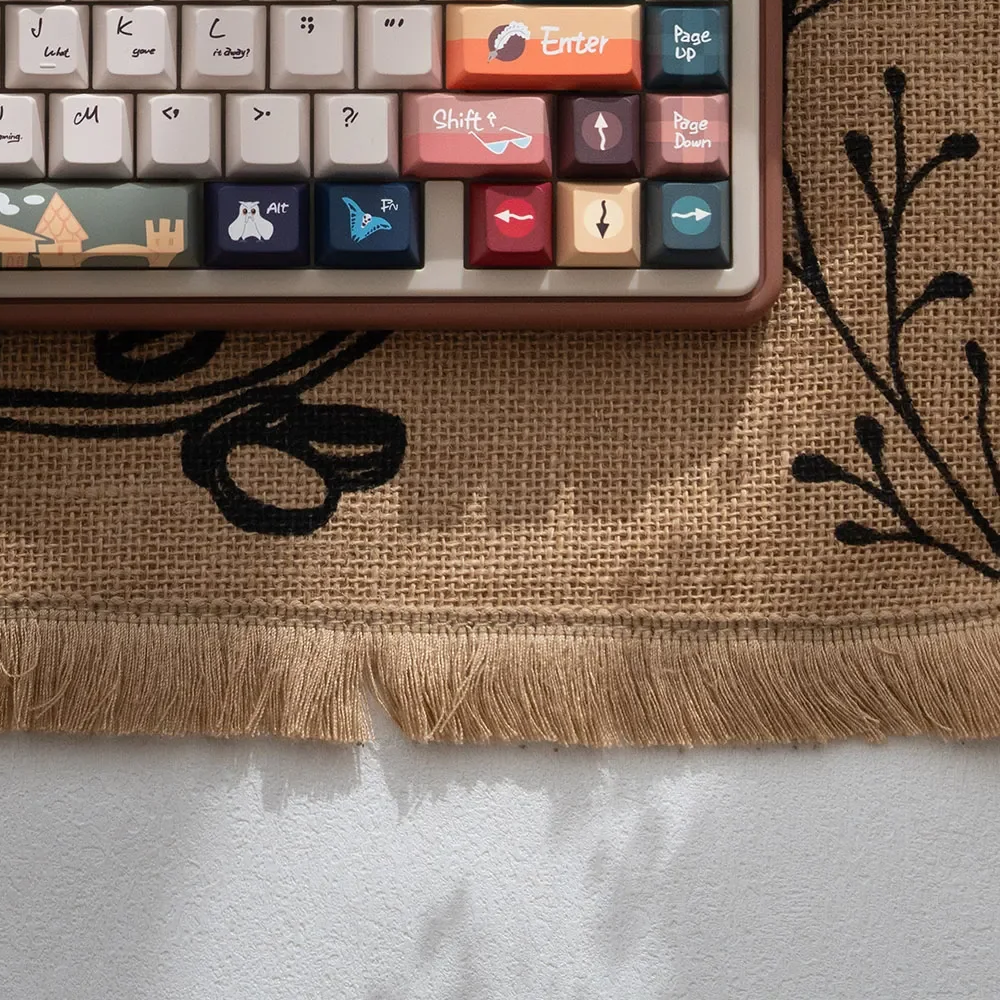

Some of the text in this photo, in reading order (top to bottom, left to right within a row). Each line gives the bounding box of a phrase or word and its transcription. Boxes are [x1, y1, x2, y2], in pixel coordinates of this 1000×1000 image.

[31, 18, 42, 38] J
[117, 16, 132, 35] K
[209, 18, 226, 38] L
[673, 24, 712, 44] Page
[540, 26, 609, 56] Enter
[74, 105, 99, 125] M
[433, 108, 485, 132] Shift
[673, 111, 709, 134] Page
[673, 132, 711, 149] Down
[267, 202, 290, 215] Alt
